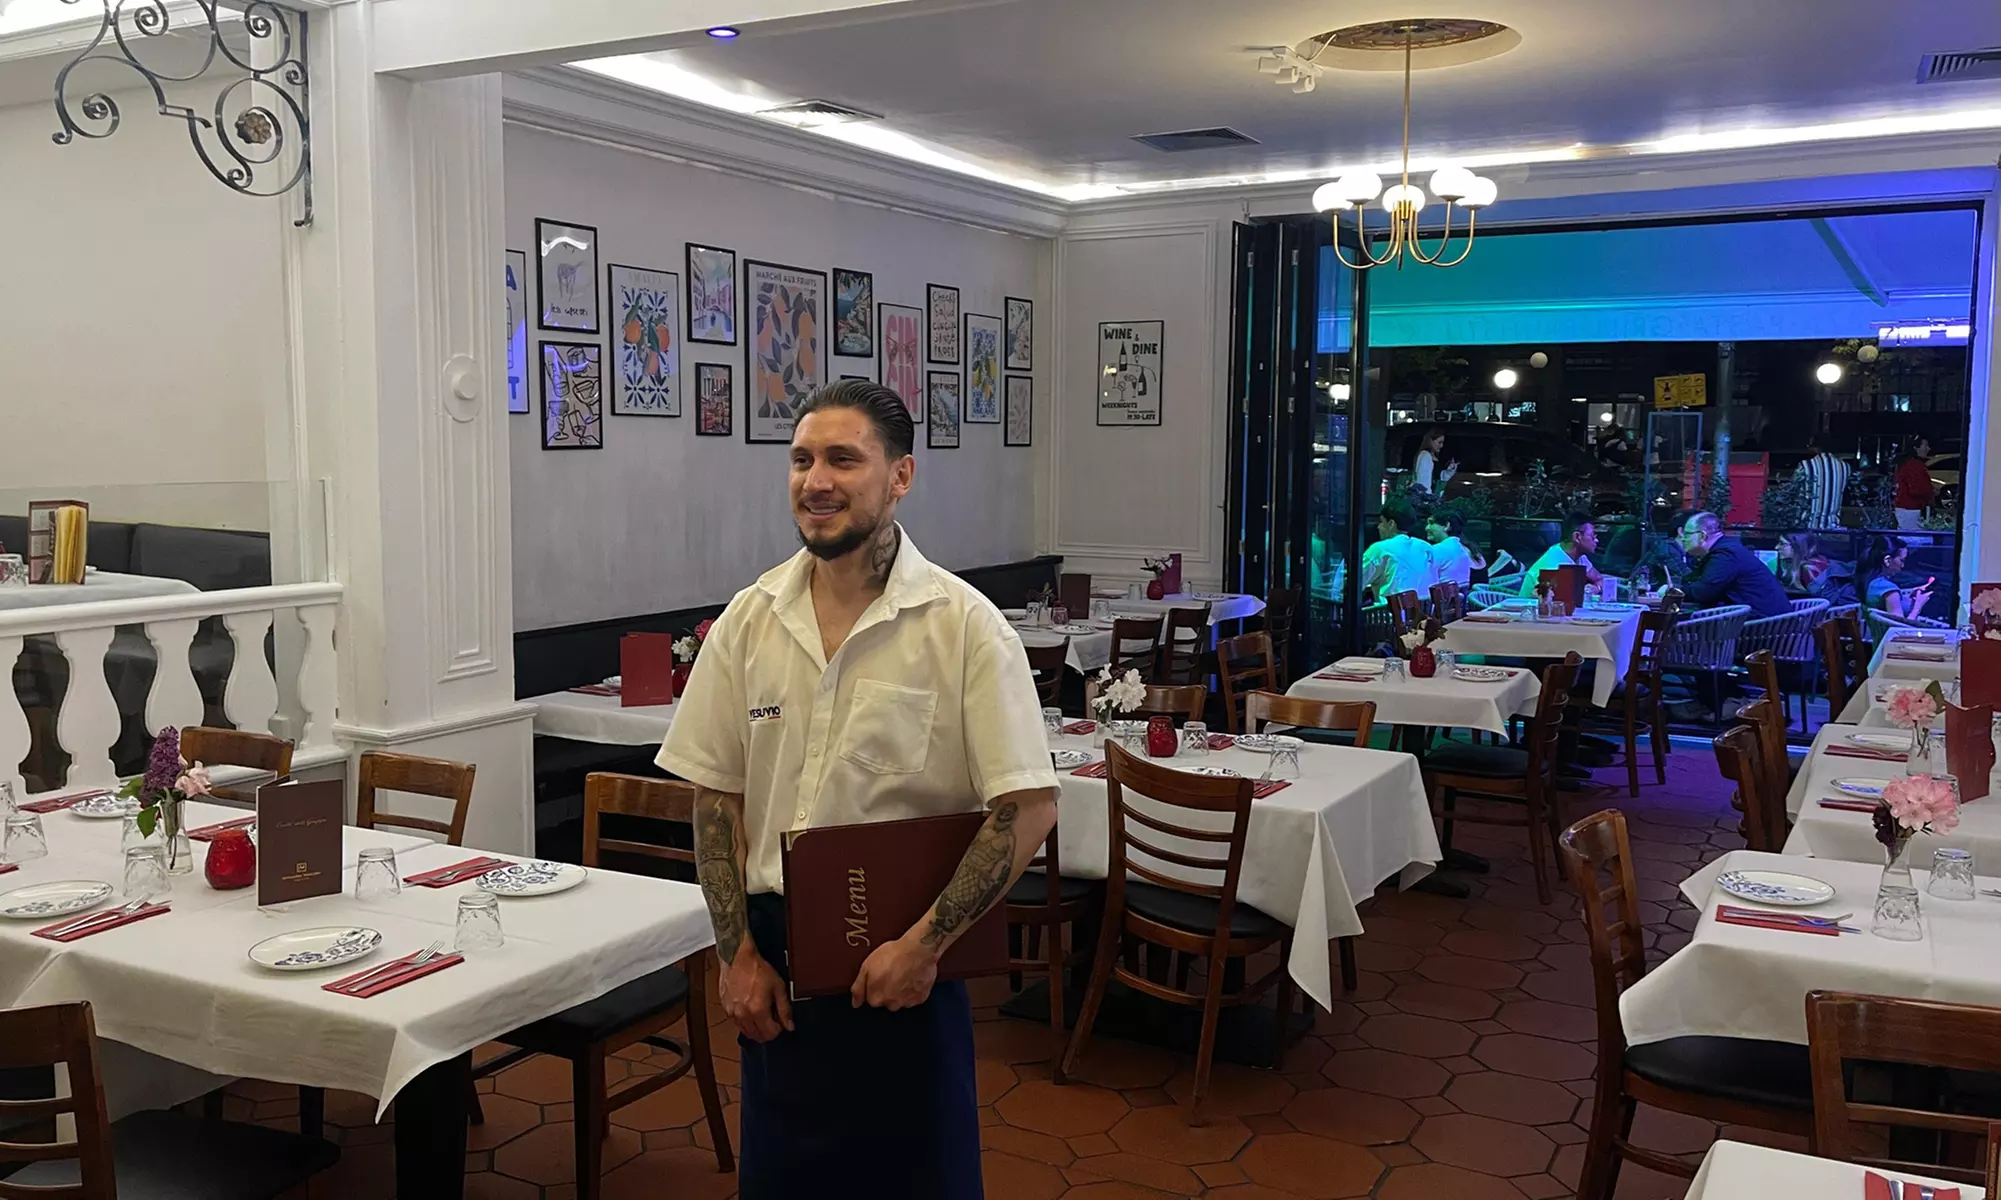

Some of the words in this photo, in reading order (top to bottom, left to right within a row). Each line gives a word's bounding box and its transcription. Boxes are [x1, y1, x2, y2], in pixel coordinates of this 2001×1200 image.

[1104, 328, 1132, 340] WINE
[1134, 333, 1139, 341] &
[1132, 343, 1158, 355] DINE
[844, 867, 871, 947] Menu
